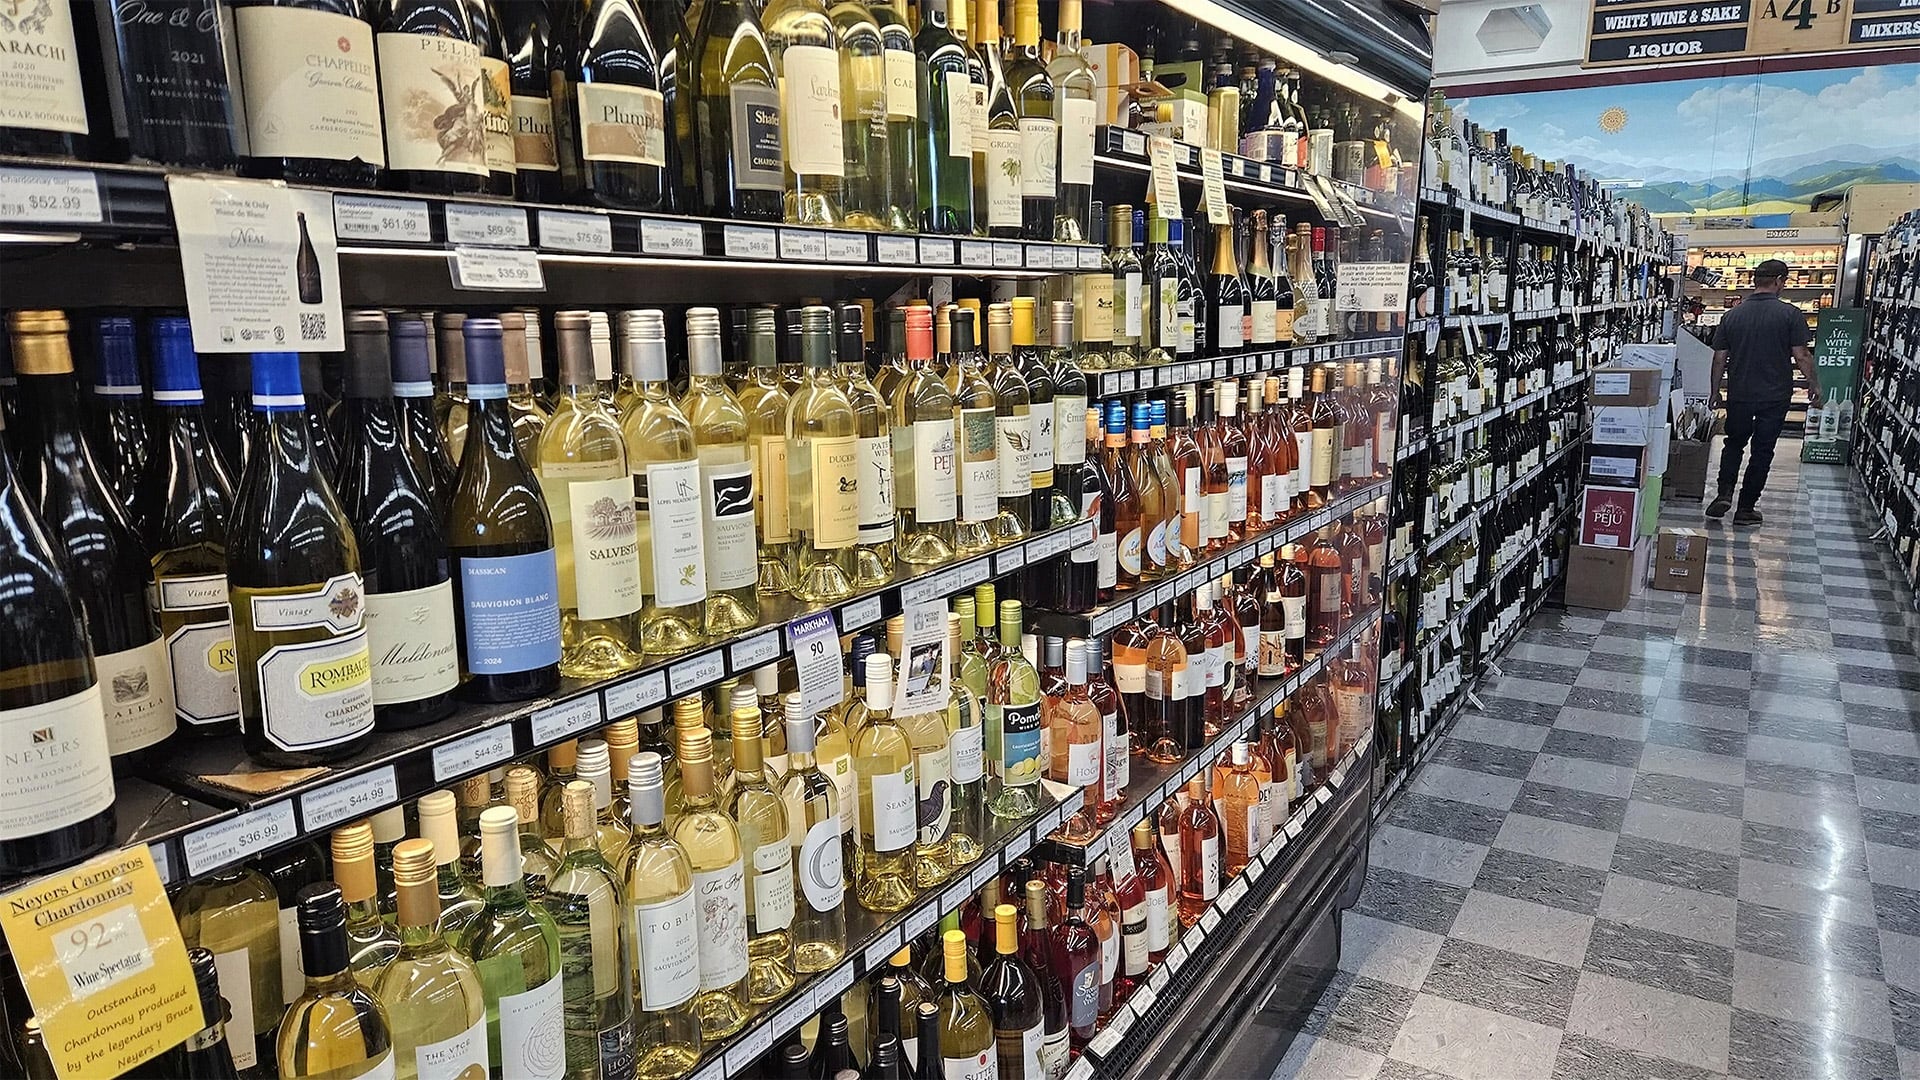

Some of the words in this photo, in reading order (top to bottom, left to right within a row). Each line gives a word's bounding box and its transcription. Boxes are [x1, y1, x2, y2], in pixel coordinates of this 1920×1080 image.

[113, 0, 164, 25] One
[1604, 14, 1649, 31] WHITE
[1650, 10, 1687, 27] WINE
[1689, 10, 1699, 24] &
[1700, 5, 1741, 22] SAKE
[1760, 0, 1778, 19] A
[1781, 0, 1818, 31] 4
[1825, 0, 1841, 15] B
[1860, 21, 1920, 39] MIXERS
[171, 50, 206, 65] 2021
[1627, 40, 1703, 59] LIQUOR
[28, 194, 81, 210] $52.99
[382, 218, 416, 231] $61.99
[576, 232, 603, 244] $75.99
[497, 267, 529, 279] $35.99
[1825, 338, 1852, 347] WITH
[1829, 328, 1850, 339] Mix
[1828, 347, 1847, 356] THE
[1818, 356, 1855, 367] BEST
[1594, 512, 1623, 528] PEJU
[468, 567, 507, 576] MASSICAN
[187, 587, 222, 598] Vintage
[470, 598, 523, 609] SAUVIGNON
[524, 592, 549, 604] BLANC
[278, 608, 313, 617] Vintage
[793, 615, 829, 636] MARKHAM
[810, 640, 824, 657] 90
[566, 710, 592, 727] $31.99
[5, 738, 81, 767] NEYERS
[474, 742, 504, 760] $44.99
[349, 787, 384, 808] $44.99
[238, 824, 280, 848] $36.99
[10, 883, 70, 914] Neyers
[71, 856, 145, 891] Carneros
[33, 880, 135, 928] Chardonnay
[70, 921, 112, 959] 92
[73, 970, 101, 989] Wine
[99, 951, 144, 980] Spectator
[86, 982, 156, 1022] Outstanding
[63, 1012, 135, 1054] Chardonnay
[138, 984, 188, 1020] produced
[65, 1061, 82, 1074] by
[85, 1048, 105, 1063] the
[108, 1017, 163, 1052] legendary
[165, 1002, 195, 1023] Bruce
[116, 1044, 155, 1070] Neyers
[425, 1050, 446, 1062] THE
